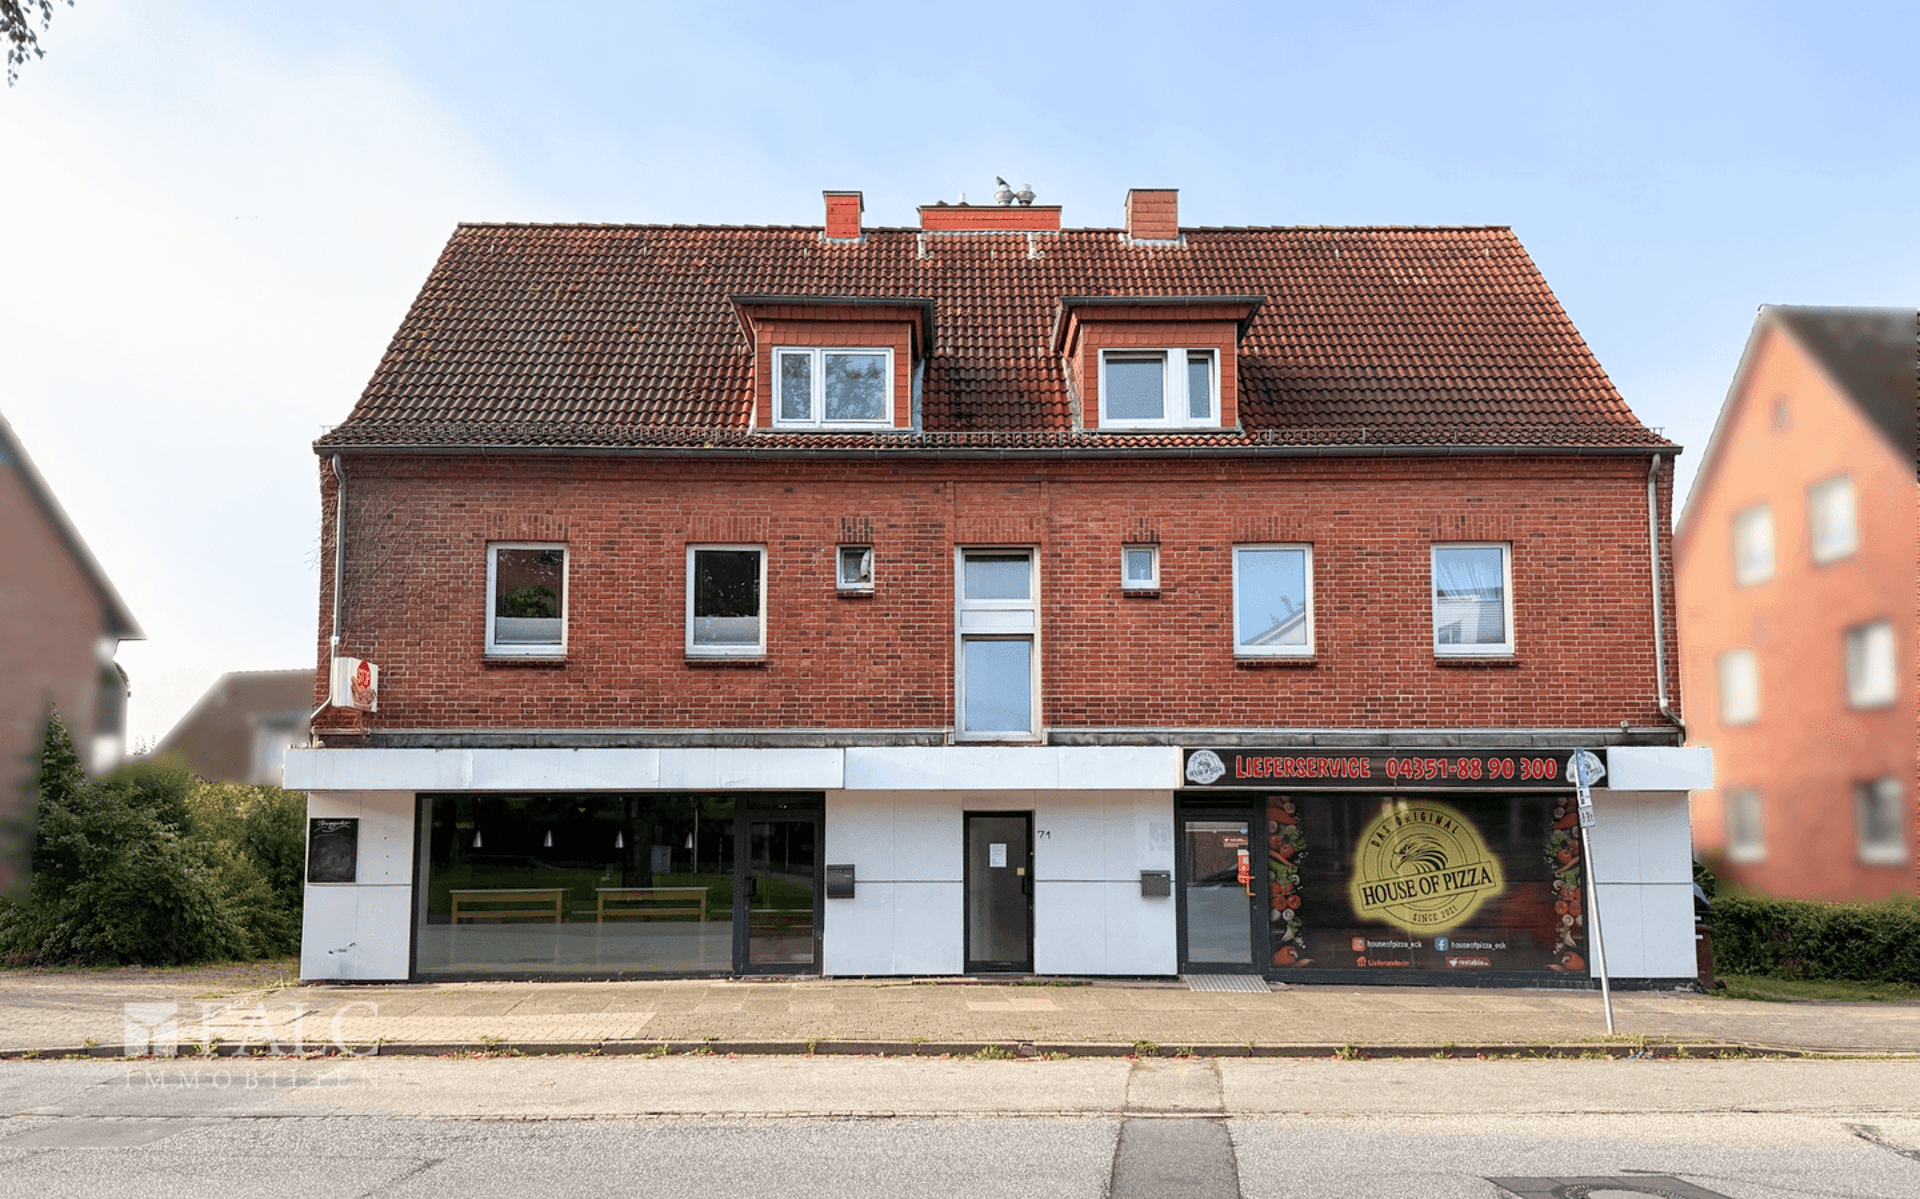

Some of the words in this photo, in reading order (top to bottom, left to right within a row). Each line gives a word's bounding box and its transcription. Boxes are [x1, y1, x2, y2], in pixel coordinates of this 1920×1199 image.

[1235, 755, 1371, 779] LIEFERSERVICE
[1386, 757, 1482, 780] 04351-88
[1487, 757, 1515, 780] 90
[1520, 757, 1557, 780] 300
[1037, 830, 1051, 839] 71
[1370, 825, 1391, 848] DAS
[1395, 811, 1459, 834] ORIGINAL
[1362, 879, 1418, 906] HOUSE
[1419, 875, 1440, 895] OF
[1442, 866, 1492, 891] PIZZA
[1412, 912, 1438, 923] SINCE
[1441, 905, 1458, 919] 2021
[1366, 940, 1422, 950] houseofpizza_eck
[1451, 941, 1506, 951] houseofpizza_eck
